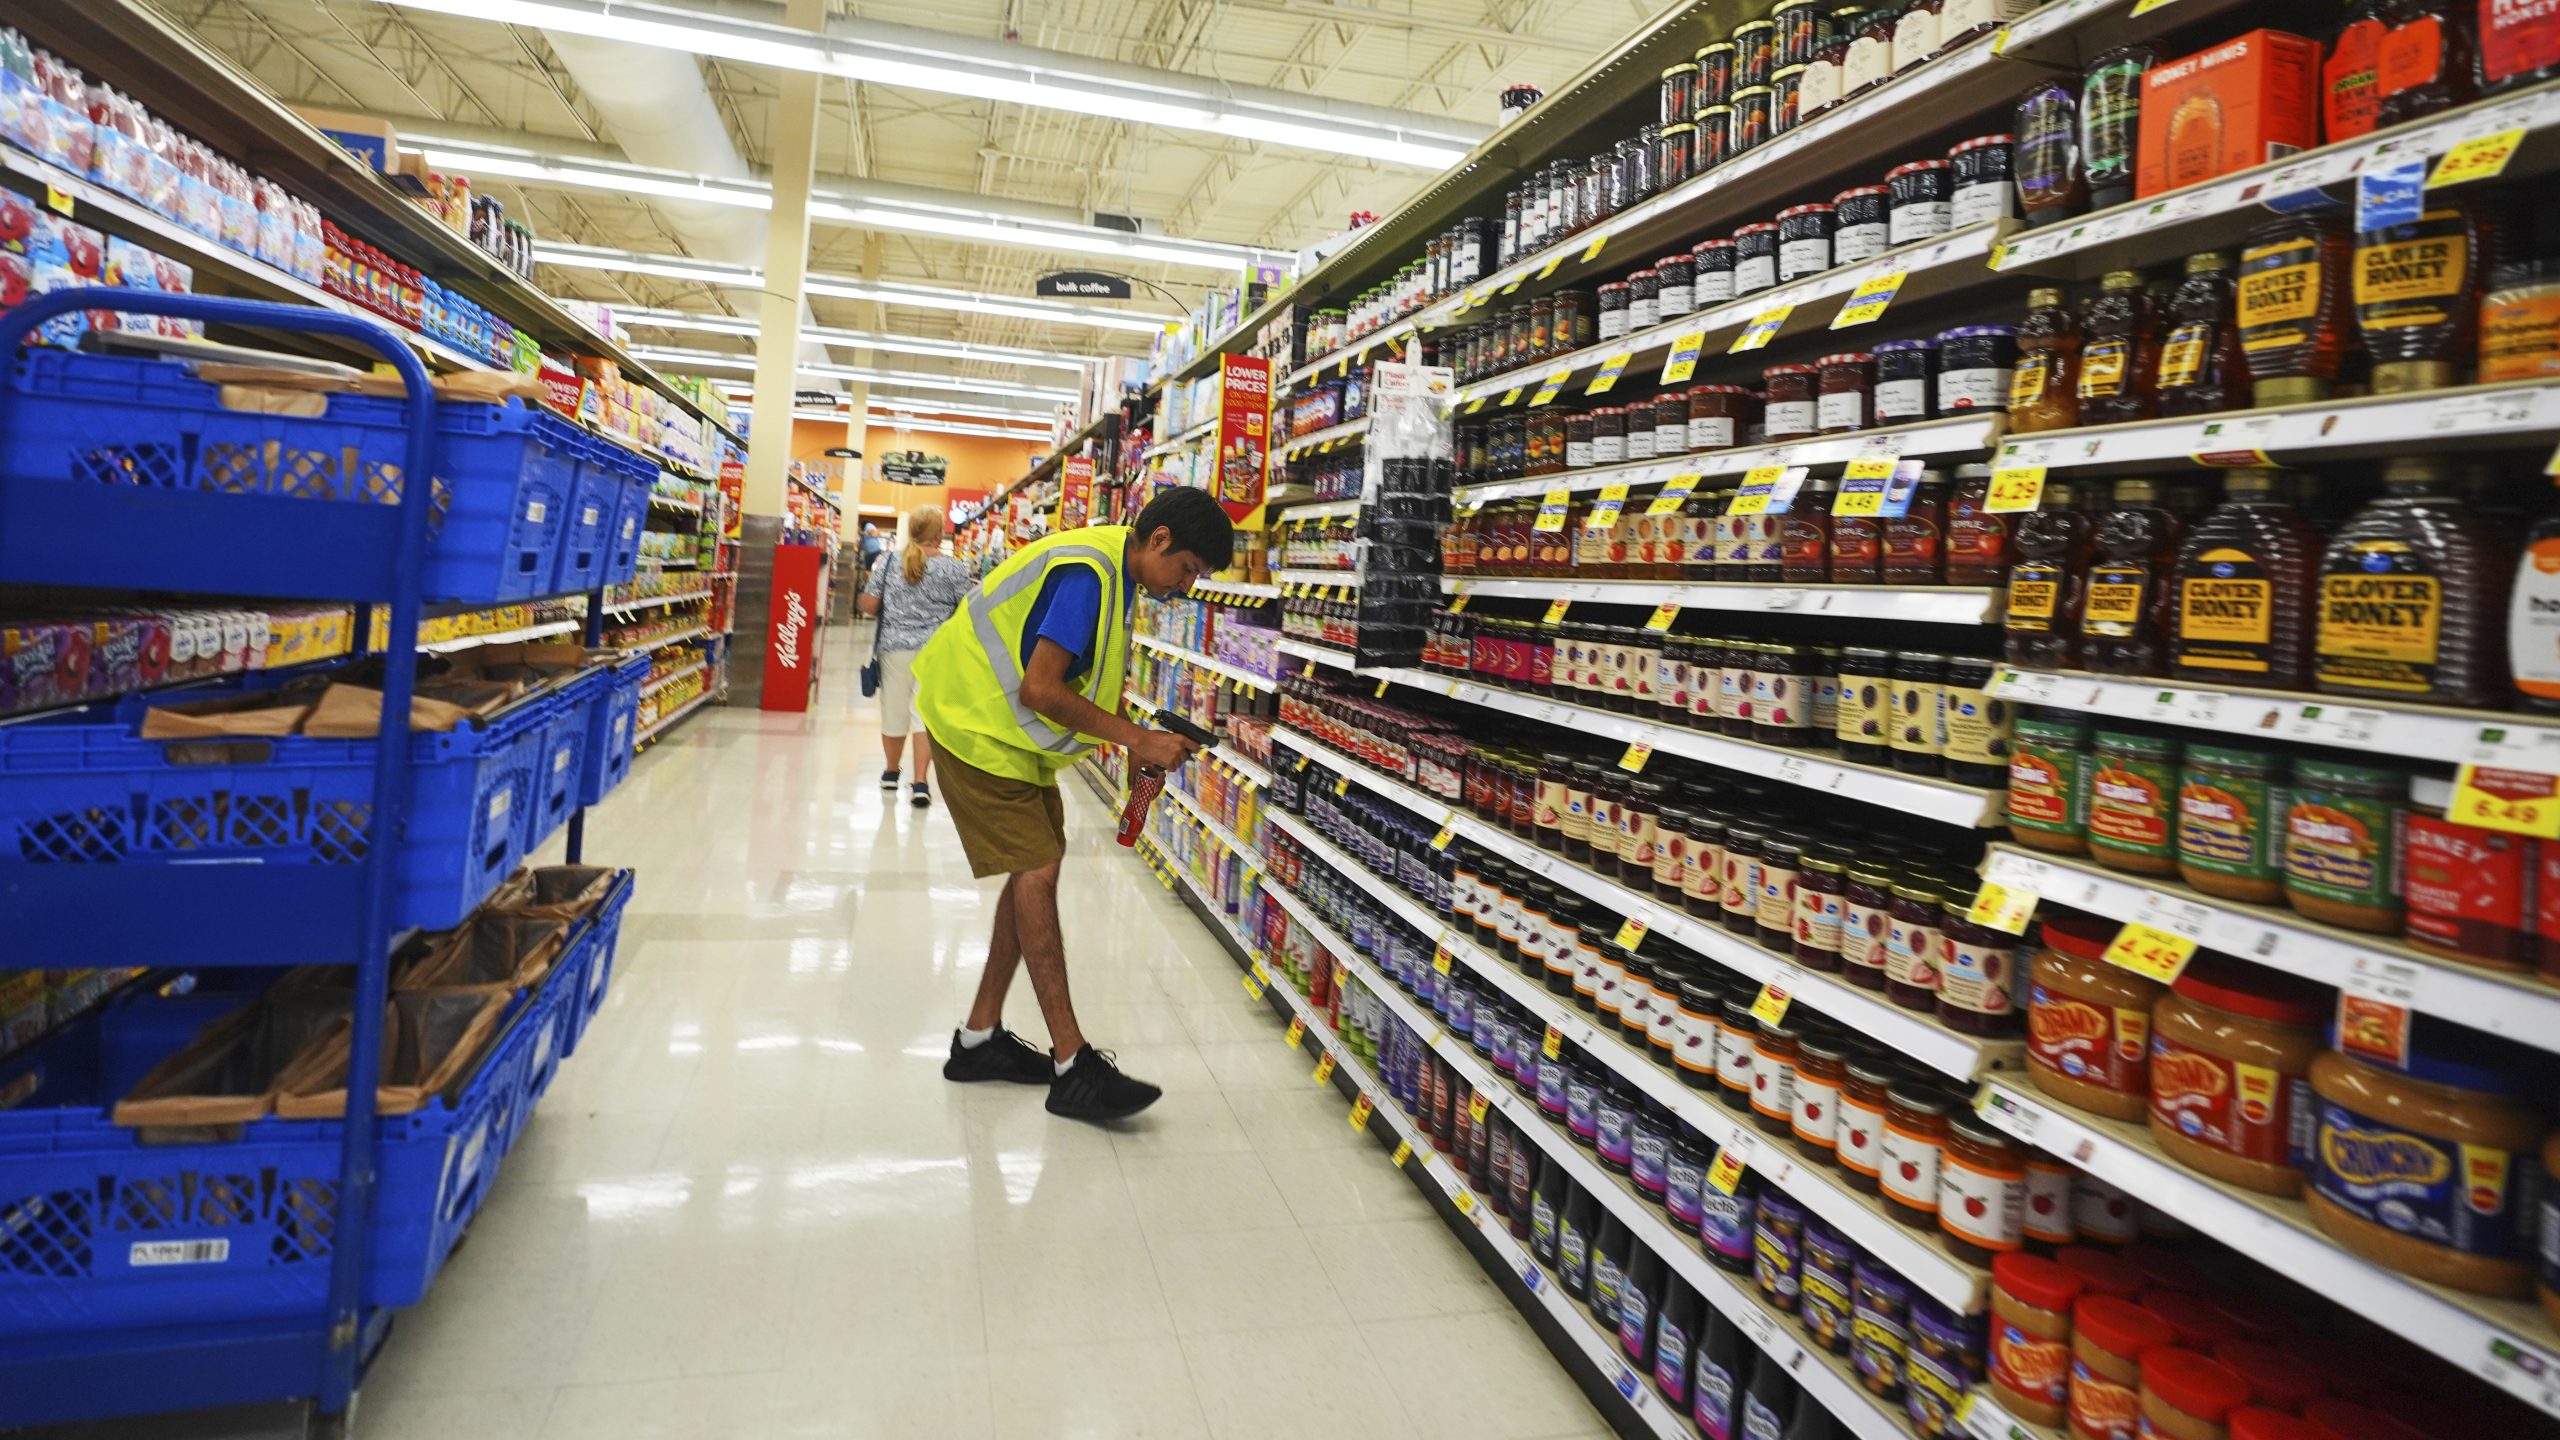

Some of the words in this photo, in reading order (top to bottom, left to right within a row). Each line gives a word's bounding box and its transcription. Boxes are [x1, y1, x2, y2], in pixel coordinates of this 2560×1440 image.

[2150, 60, 2198, 88] HONEY
[2200, 41, 2248, 69] MINIS
[2364, 243, 2449, 267] CLOVER
[2245, 270, 2307, 294] CLOVER
[2365, 259, 2446, 286] HONEY
[1056, 281, 1079, 293] bulk
[1080, 282, 1110, 294] coffee
[2245, 286, 2306, 311] HONEY
[1225, 377, 1268, 394] PRICES
[1226, 365, 1268, 382] LOWER
[2188, 582, 2263, 599] CLOVER
[2328, 579, 2432, 601] CLOVER
[2188, 601, 2260, 619] HONEY
[2328, 601, 2430, 627] HONEY
[774, 590, 807, 669] Kellogg's
[2472, 799, 2540, 824] 6.49
[2118, 939, 2182, 971] 4.49
